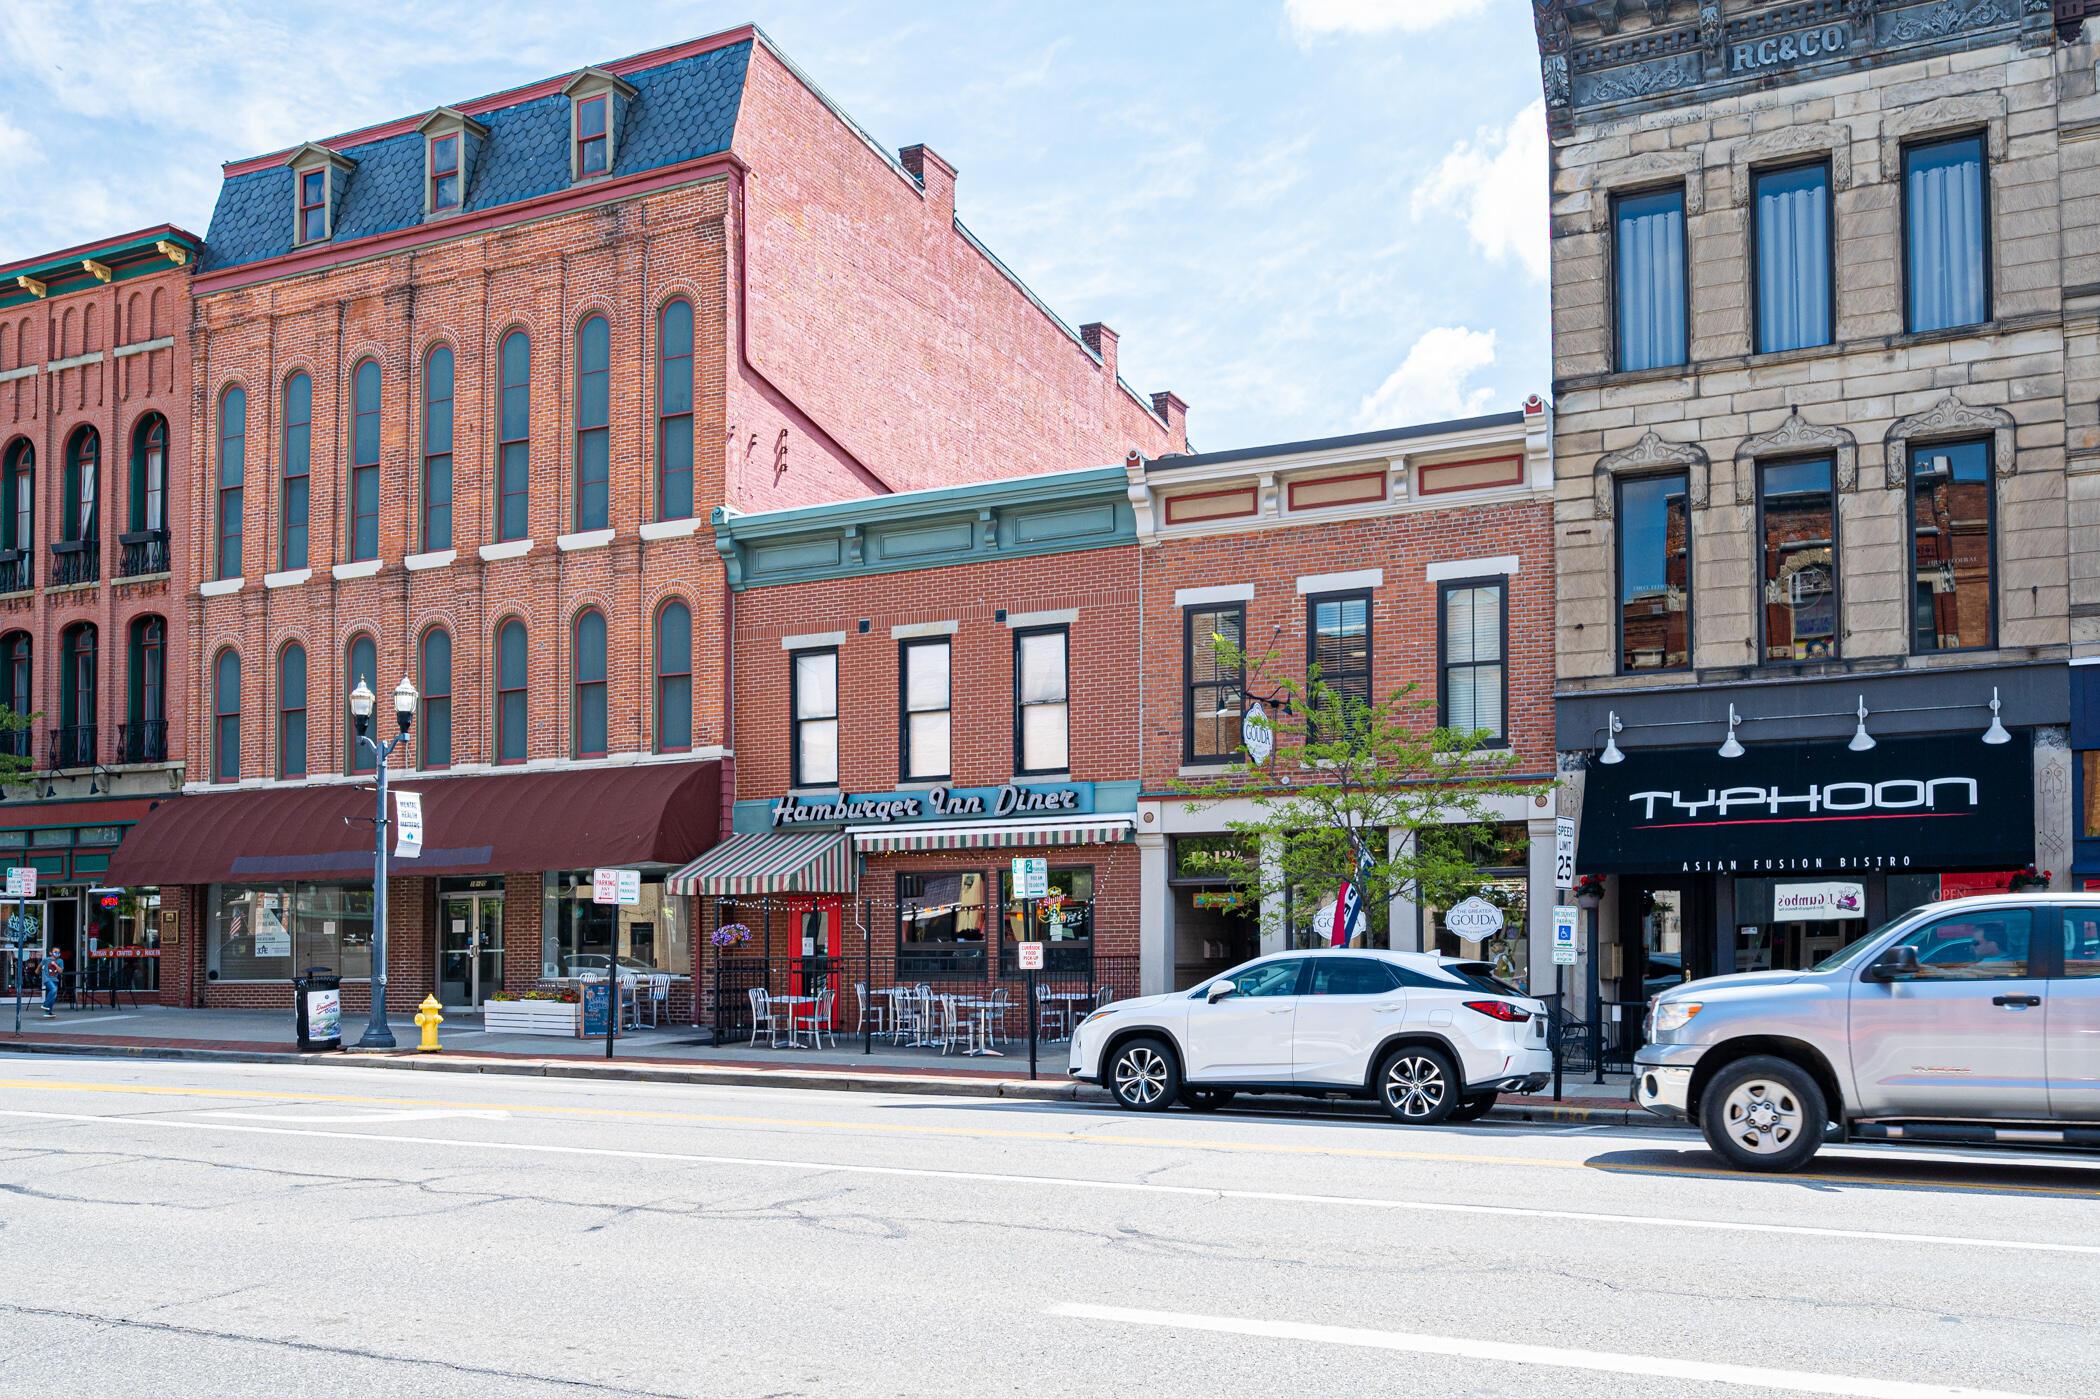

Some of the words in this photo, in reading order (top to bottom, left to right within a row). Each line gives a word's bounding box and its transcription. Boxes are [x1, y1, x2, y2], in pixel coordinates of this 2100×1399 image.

[1246, 724, 1270, 745] GOUDA
[1629, 776, 1978, 819] TYPHOON
[772, 791, 921, 827] Hamburger
[929, 785, 985, 816] Inn
[993, 783, 1079, 817] Diner
[1557, 825, 1573, 838] SPEED
[1559, 841, 1572, 852] LIMIT
[1026, 861, 1032, 872] 2
[1557, 855, 1572, 881] 25
[1682, 860, 1737, 873] ASIAN
[1753, 858, 1823, 870] FUSION
[1840, 855, 1910, 867] BISTRO
[596, 879, 616, 887] PARKING
[100, 897, 119, 906] OPEN
[1451, 914, 1497, 926] GOUDA
